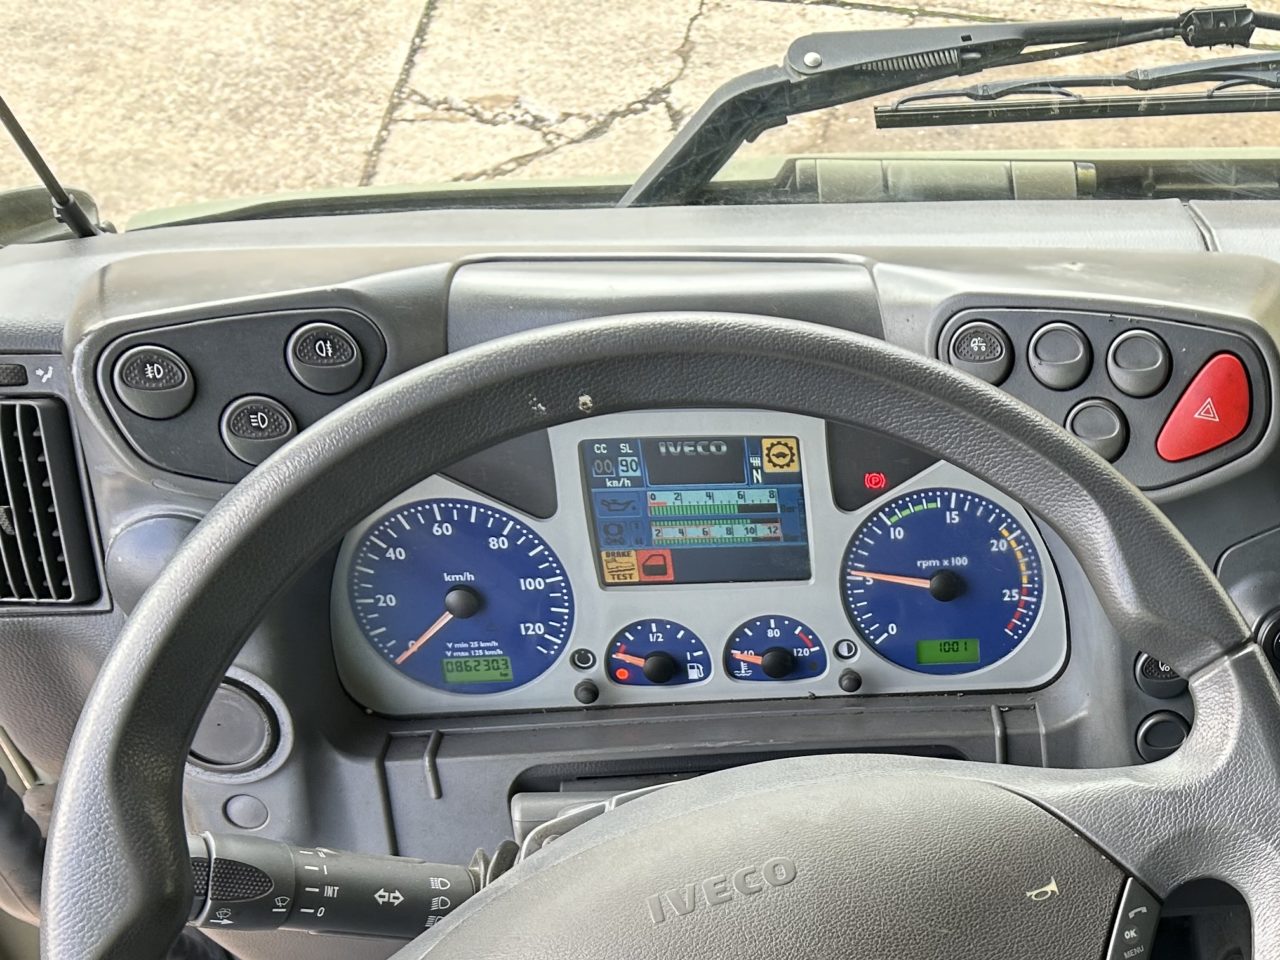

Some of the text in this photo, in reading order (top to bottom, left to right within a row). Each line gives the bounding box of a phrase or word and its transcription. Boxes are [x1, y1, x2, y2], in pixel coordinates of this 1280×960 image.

[594, 443, 633, 454] CC SL
[658, 441, 728, 456] IVECO
[620, 458, 639, 473] 90
[753, 471, 762, 484] N
[650, 490, 775, 501] 0 2 4 6 8
[946, 511, 960, 524] 15
[432, 522, 453, 536] 60
[655, 525, 779, 537] 2 4 6 8 10 12
[890, 527, 904, 539] 10
[488, 536, 509, 550] 80
[990, 539, 1007, 552] 20
[385, 547, 406, 560] 40
[917, 559, 940, 569] rpm
[951, 557, 968, 566] 100
[443, 572, 475, 582] km/h
[610, 573, 635, 581] TEST
[519, 578, 545, 590] 100
[375, 594, 397, 607] 20
[1002, 589, 1019, 601] 25
[519, 623, 545, 635] 120
[767, 628, 781, 638] 80
[888, 624, 897, 635] 0
[649, 633, 664, 642] 1/2
[793, 648, 810, 657] 120
[323, 885, 339, 898] INT
[647, 856, 797, 924] IVECO
[1124, 928, 1138, 939] OK
[1123, 945, 1145, 959] MENU
